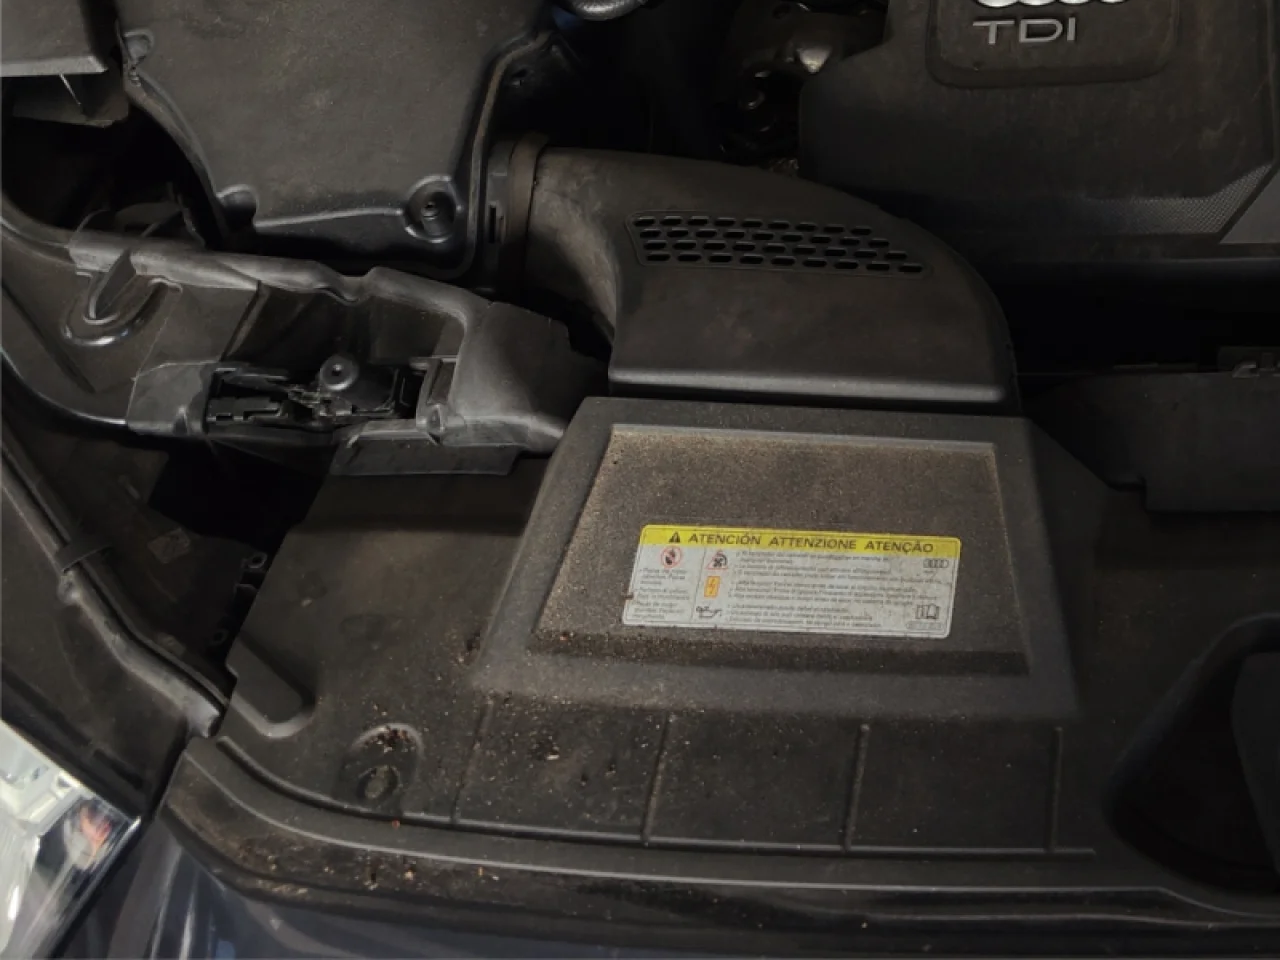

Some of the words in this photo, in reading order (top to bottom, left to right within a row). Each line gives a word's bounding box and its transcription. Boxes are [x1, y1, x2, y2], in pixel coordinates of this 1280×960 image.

[972, 17, 1076, 45] TDI
[688, 532, 761, 546] ATENCIÓN
[768, 536, 857, 550] ATTENZIONE
[863, 539, 934, 555] ATENÇÃO
